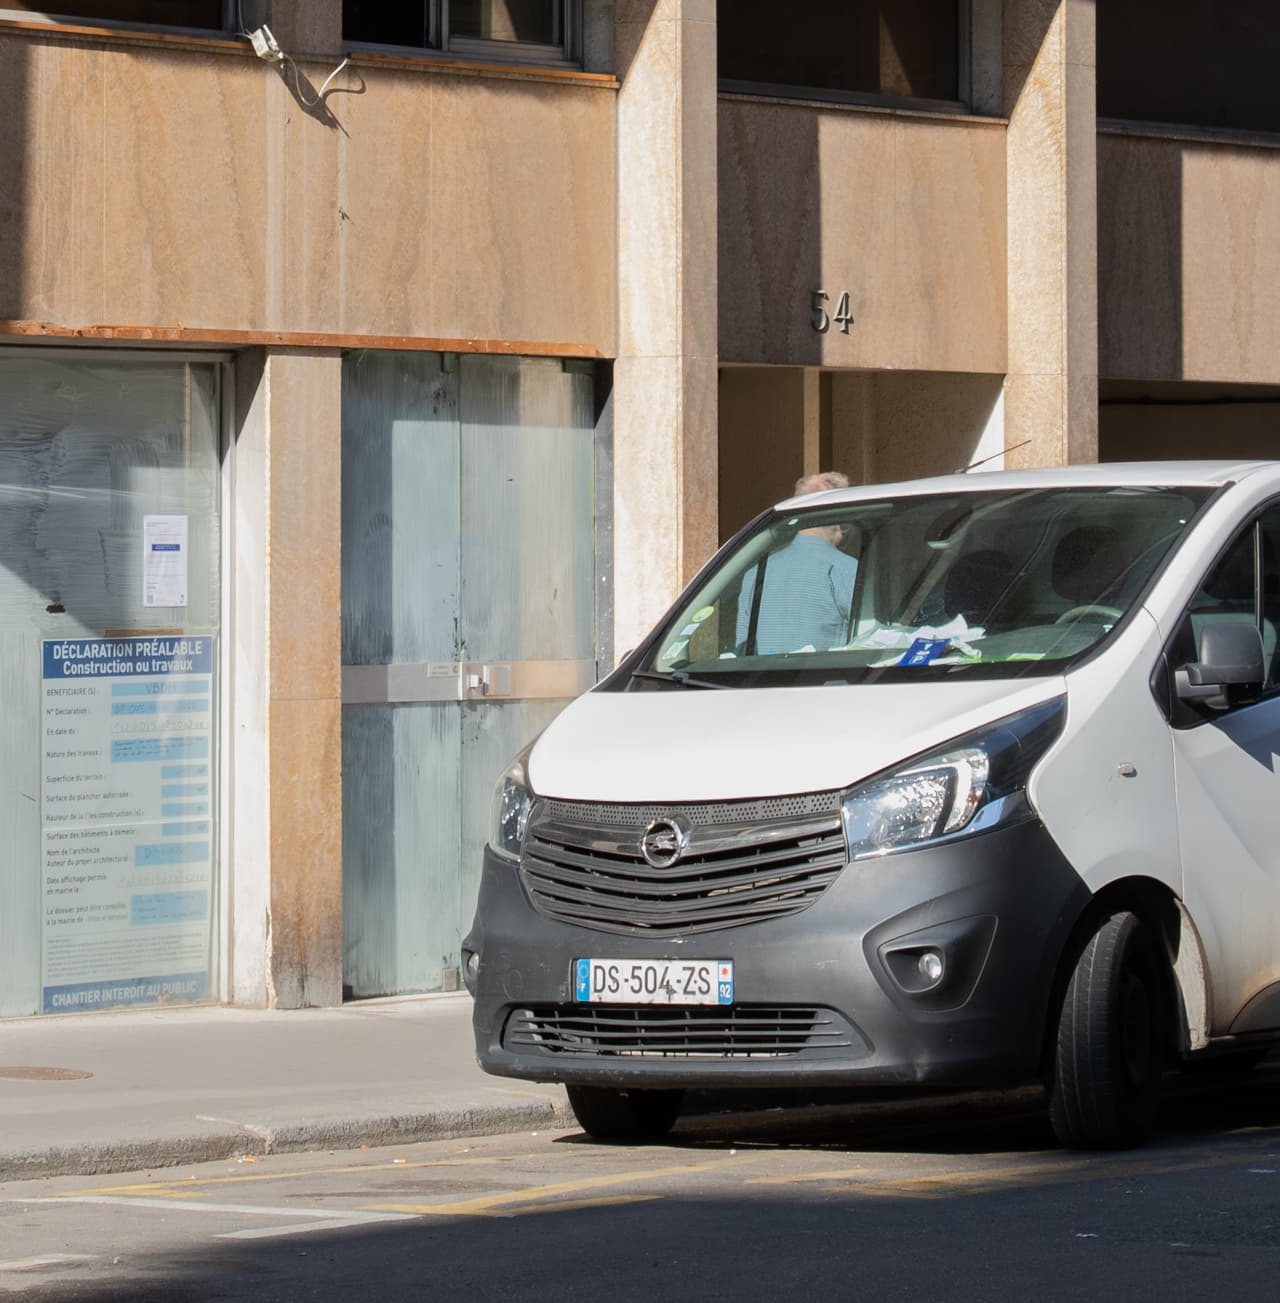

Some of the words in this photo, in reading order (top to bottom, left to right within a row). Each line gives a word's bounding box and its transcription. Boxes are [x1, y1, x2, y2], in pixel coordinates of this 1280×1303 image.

[810, 289, 855, 335] 54
[53, 642, 133, 660] DÉCLARATION
[135, 638, 203, 657] PRÉALABLE
[63, 659, 134, 675] Construction
[135, 662, 150, 672] ou
[151, 658, 193, 672] travaux
[593, 965, 711, 995] DS-504-ZS
[719, 984, 731, 999] 92
[52, 990, 100, 1007] CHANTIER
[102, 985, 146, 1002] INTERDIT
[147, 983, 161, 996] AU
[162, 980, 197, 995] PUBLIC
